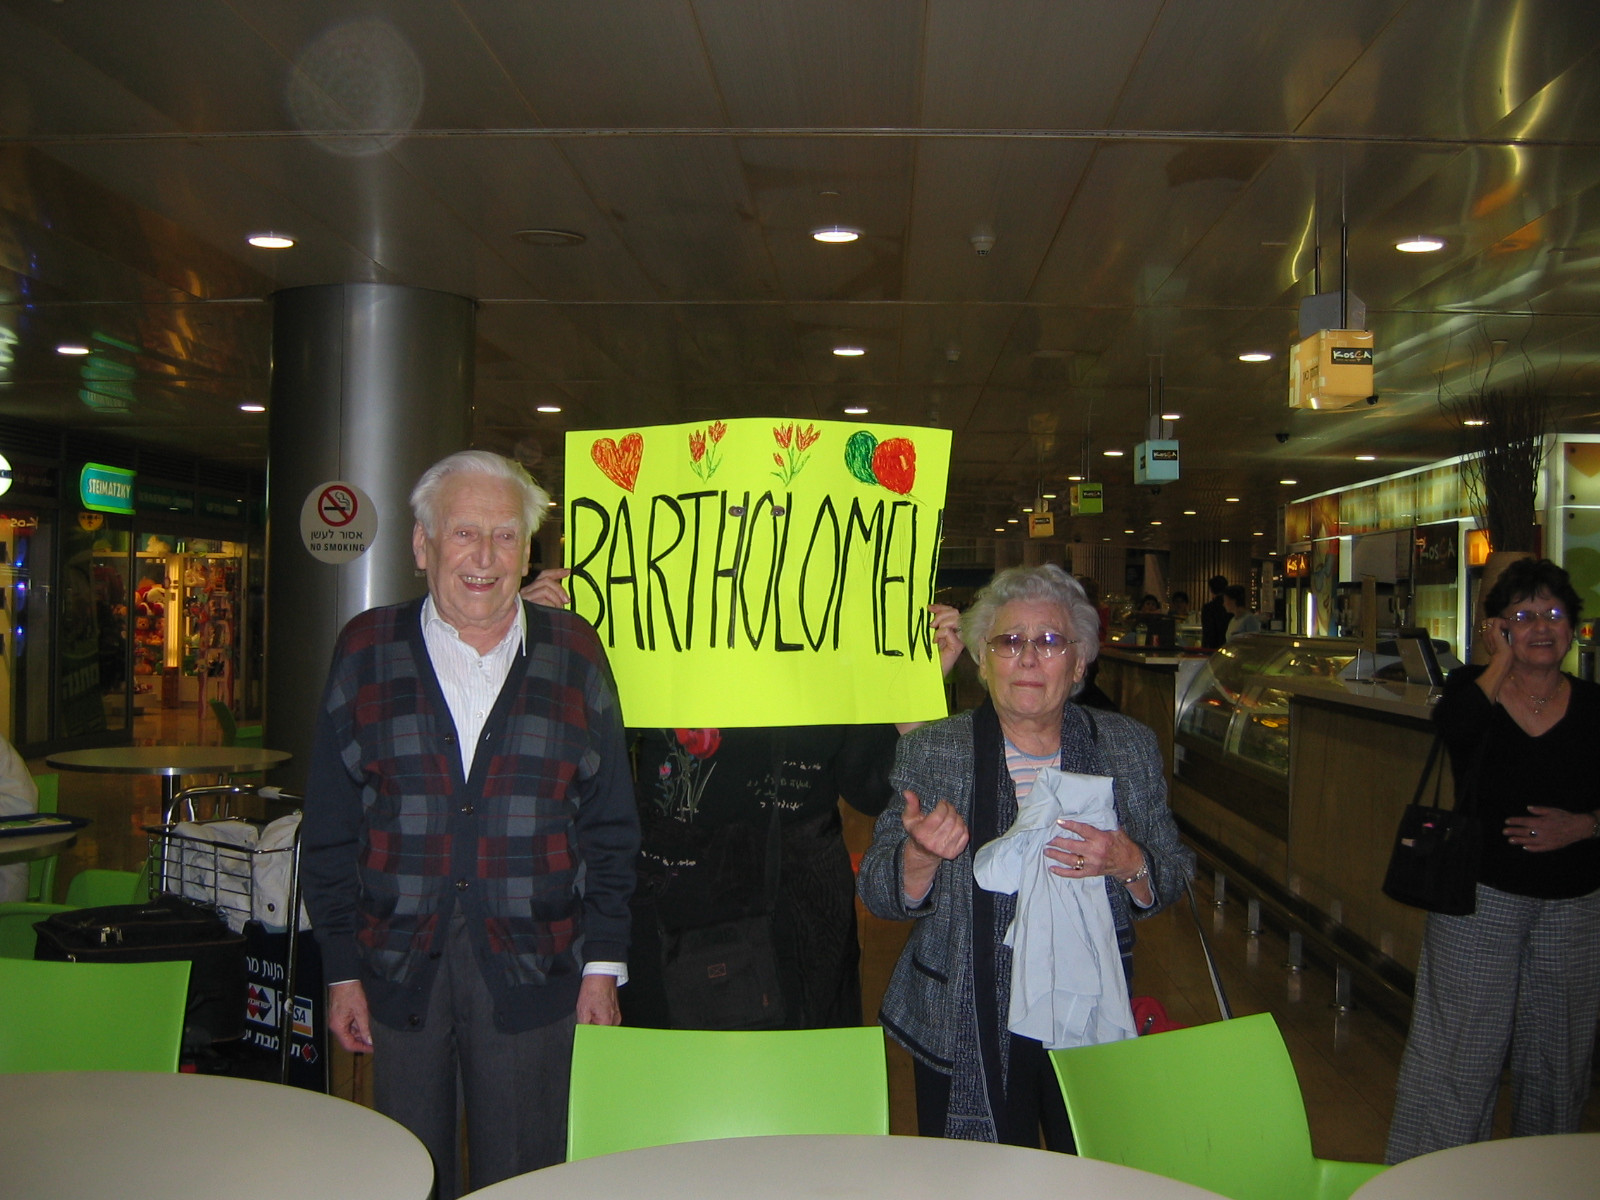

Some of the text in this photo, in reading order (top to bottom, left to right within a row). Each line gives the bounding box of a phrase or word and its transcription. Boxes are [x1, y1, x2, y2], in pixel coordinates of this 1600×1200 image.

[88, 478, 131, 499] STEIMATZKY
[310, 529, 363, 540] אסור לעשן
[310, 543, 365, 551] NO SMOKING
[569, 490, 944, 662] BARTHOLOMEW
